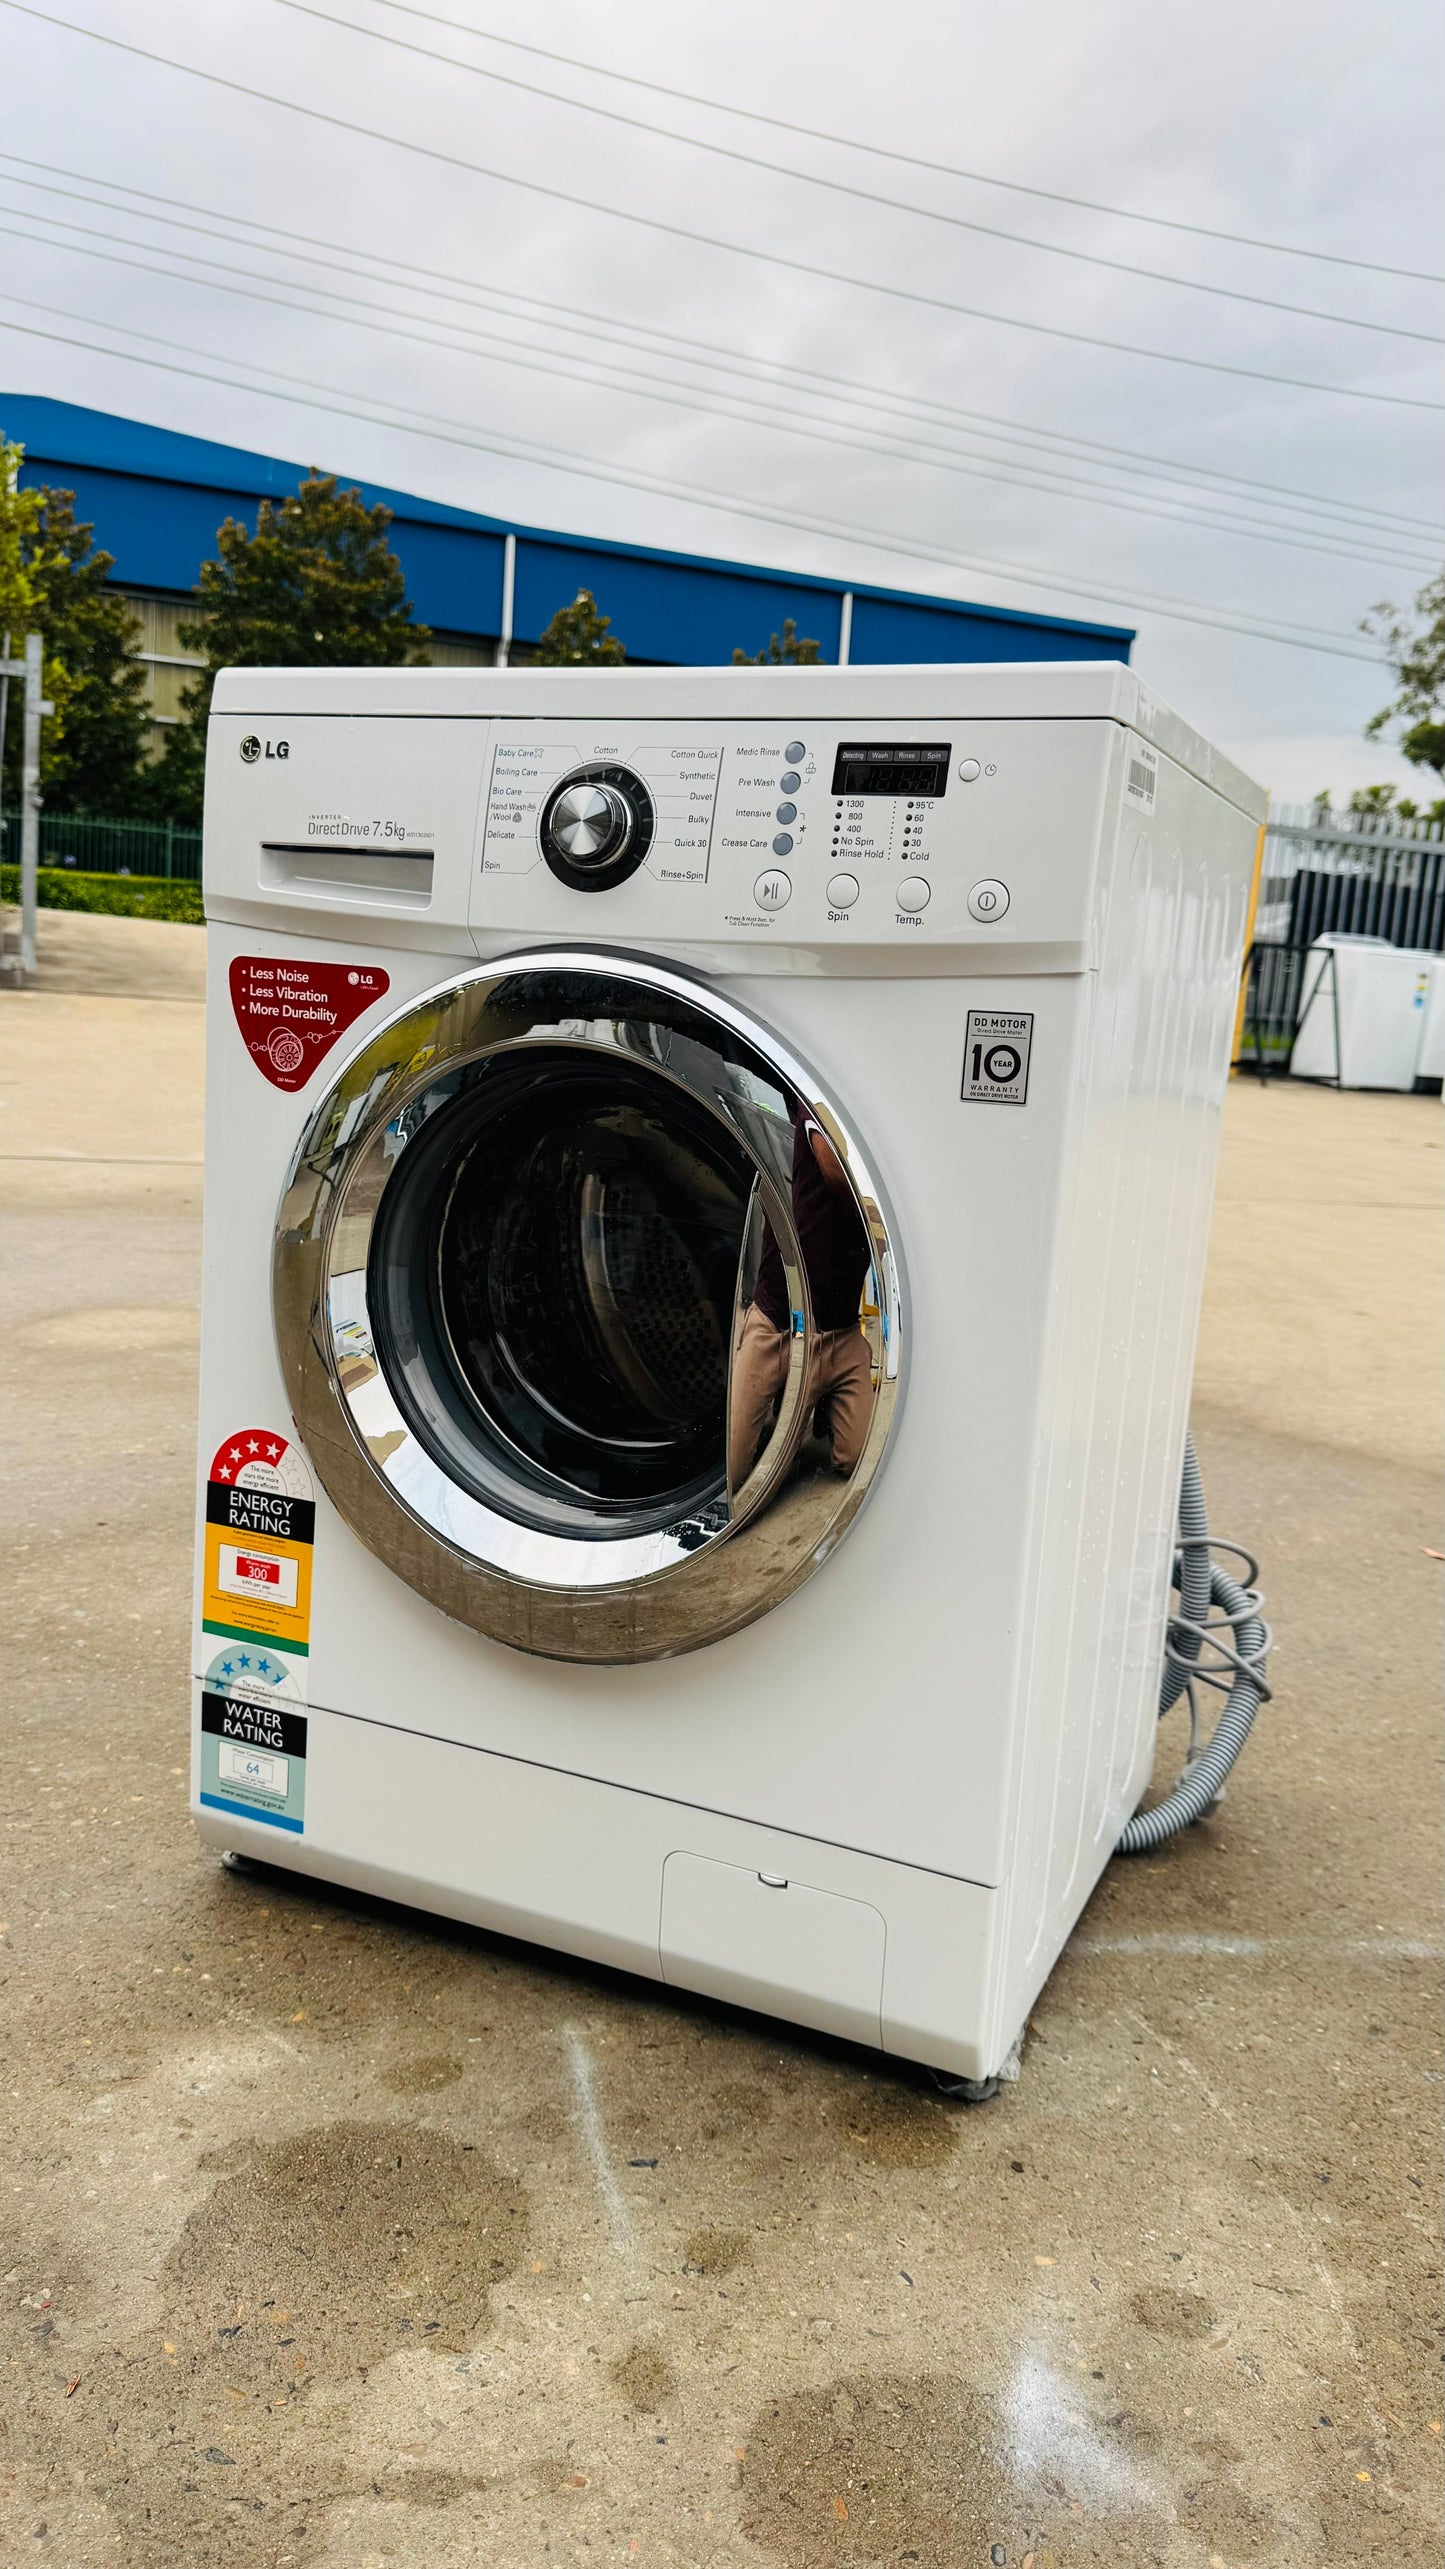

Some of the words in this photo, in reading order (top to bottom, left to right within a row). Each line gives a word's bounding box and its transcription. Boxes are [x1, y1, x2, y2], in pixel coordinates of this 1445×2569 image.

[265, 741, 290, 759] LG
[498, 748, 515, 757] Baby
[518, 749, 534, 757] Care
[594, 746, 618, 754] Cotton
[671, 750, 695, 758] Cotton
[697, 751, 719, 759] Quick
[737, 748, 758, 756] Medic
[760, 748, 780, 756] Rinse
[842, 752, 865, 760] Detecting
[927, 752, 942, 760] Spin
[496, 767, 520, 777] Boiling
[522, 768, 538, 776] Care
[680, 771, 716, 781] Synthetic
[738, 778, 751, 786] Pre
[753, 778, 775, 787] Wash
[492, 787, 503, 795] Bio
[690, 792, 713, 800] Duvet
[509, 803, 527, 811] Wash
[846, 800, 865, 808] 1300
[915, 801, 934, 809] 95°C
[489, 813, 511, 821] /Wool
[736, 809, 771, 817] Intensive
[688, 815, 710, 825] Bulky
[914, 814, 924, 822] 60
[372, 820, 405, 841] 7.5kg
[846, 825, 862, 833] 400
[488, 831, 515, 839] Delicate
[674, 838, 695, 847] Quick
[697, 839, 707, 847] 30
[722, 839, 748, 847] Crease
[749, 839, 768, 847] Care
[840, 837, 853, 845] No
[855, 837, 874, 847] Spin
[911, 839, 921, 847] 30
[839, 849, 862, 857] Rinse
[864, 850, 884, 858] Hold
[909, 852, 930, 860] Cold
[484, 861, 501, 870] Spin
[660, 870, 704, 880] Rinse+Spin
[827, 911, 849, 922] Spin
[894, 914, 925, 926] Temp.
[250, 966, 274, 980] Less
[276, 968, 309, 983] Noise
[361, 975, 373, 984] LG
[250, 984, 274, 998] Less
[276, 986, 328, 1003] Vibration
[250, 1002, 279, 1016] More
[282, 1005, 337, 1025] Durability
[974, 1018, 988, 1027] DD
[991, 1018, 1027, 1029] MOTOR
[972, 1043, 1021, 1083] 10
[993, 1059, 1013, 1068] YEAR
[970, 1084, 1019, 1094] WARRANTY
[260, 1482, 279, 1490] efficient
[229, 1490, 294, 1517] ENERGY
[229, 1512, 291, 1536] RATING
[237, 1549, 252, 1557] Energy
[252, 1553, 280, 1562] consumption
[245, 1559, 260, 1567] Warm
[248, 1565, 268, 1581] 300
[225, 1701, 282, 1730] WATER
[223, 1718, 283, 1748] RATING
[246, 1762, 260, 1775] 64
